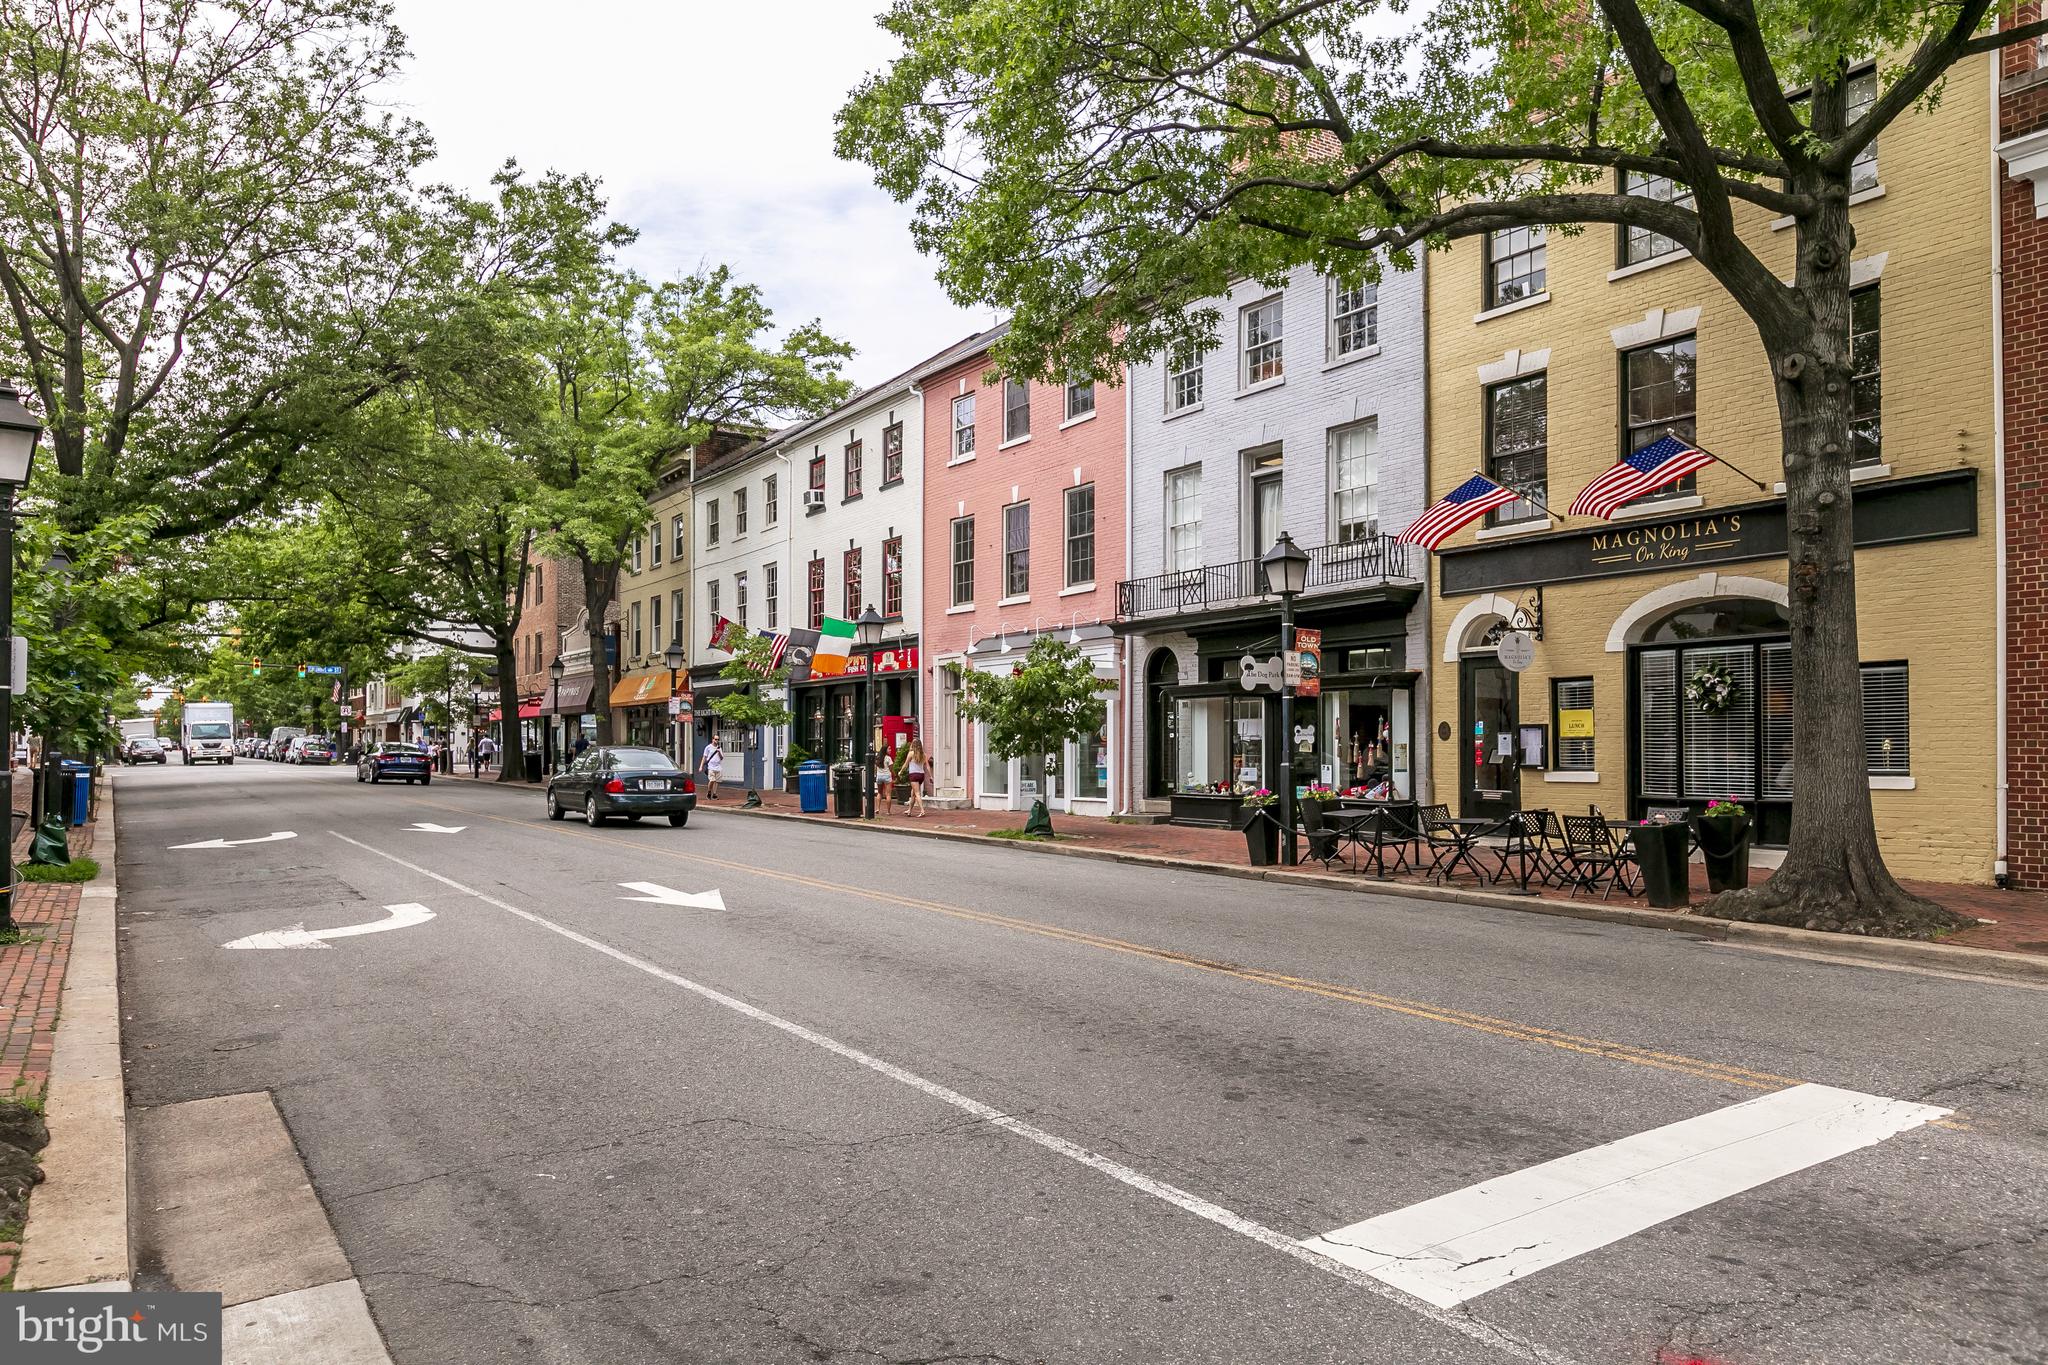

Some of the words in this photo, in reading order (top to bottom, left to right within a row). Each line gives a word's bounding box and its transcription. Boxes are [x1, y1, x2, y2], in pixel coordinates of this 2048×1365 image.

[1592, 515, 1741, 551] MAGNOLIA'S
[1636, 545, 1655, 563] On
[1659, 542, 1690, 560] King
[1257, 671, 1268, 679] Dog
